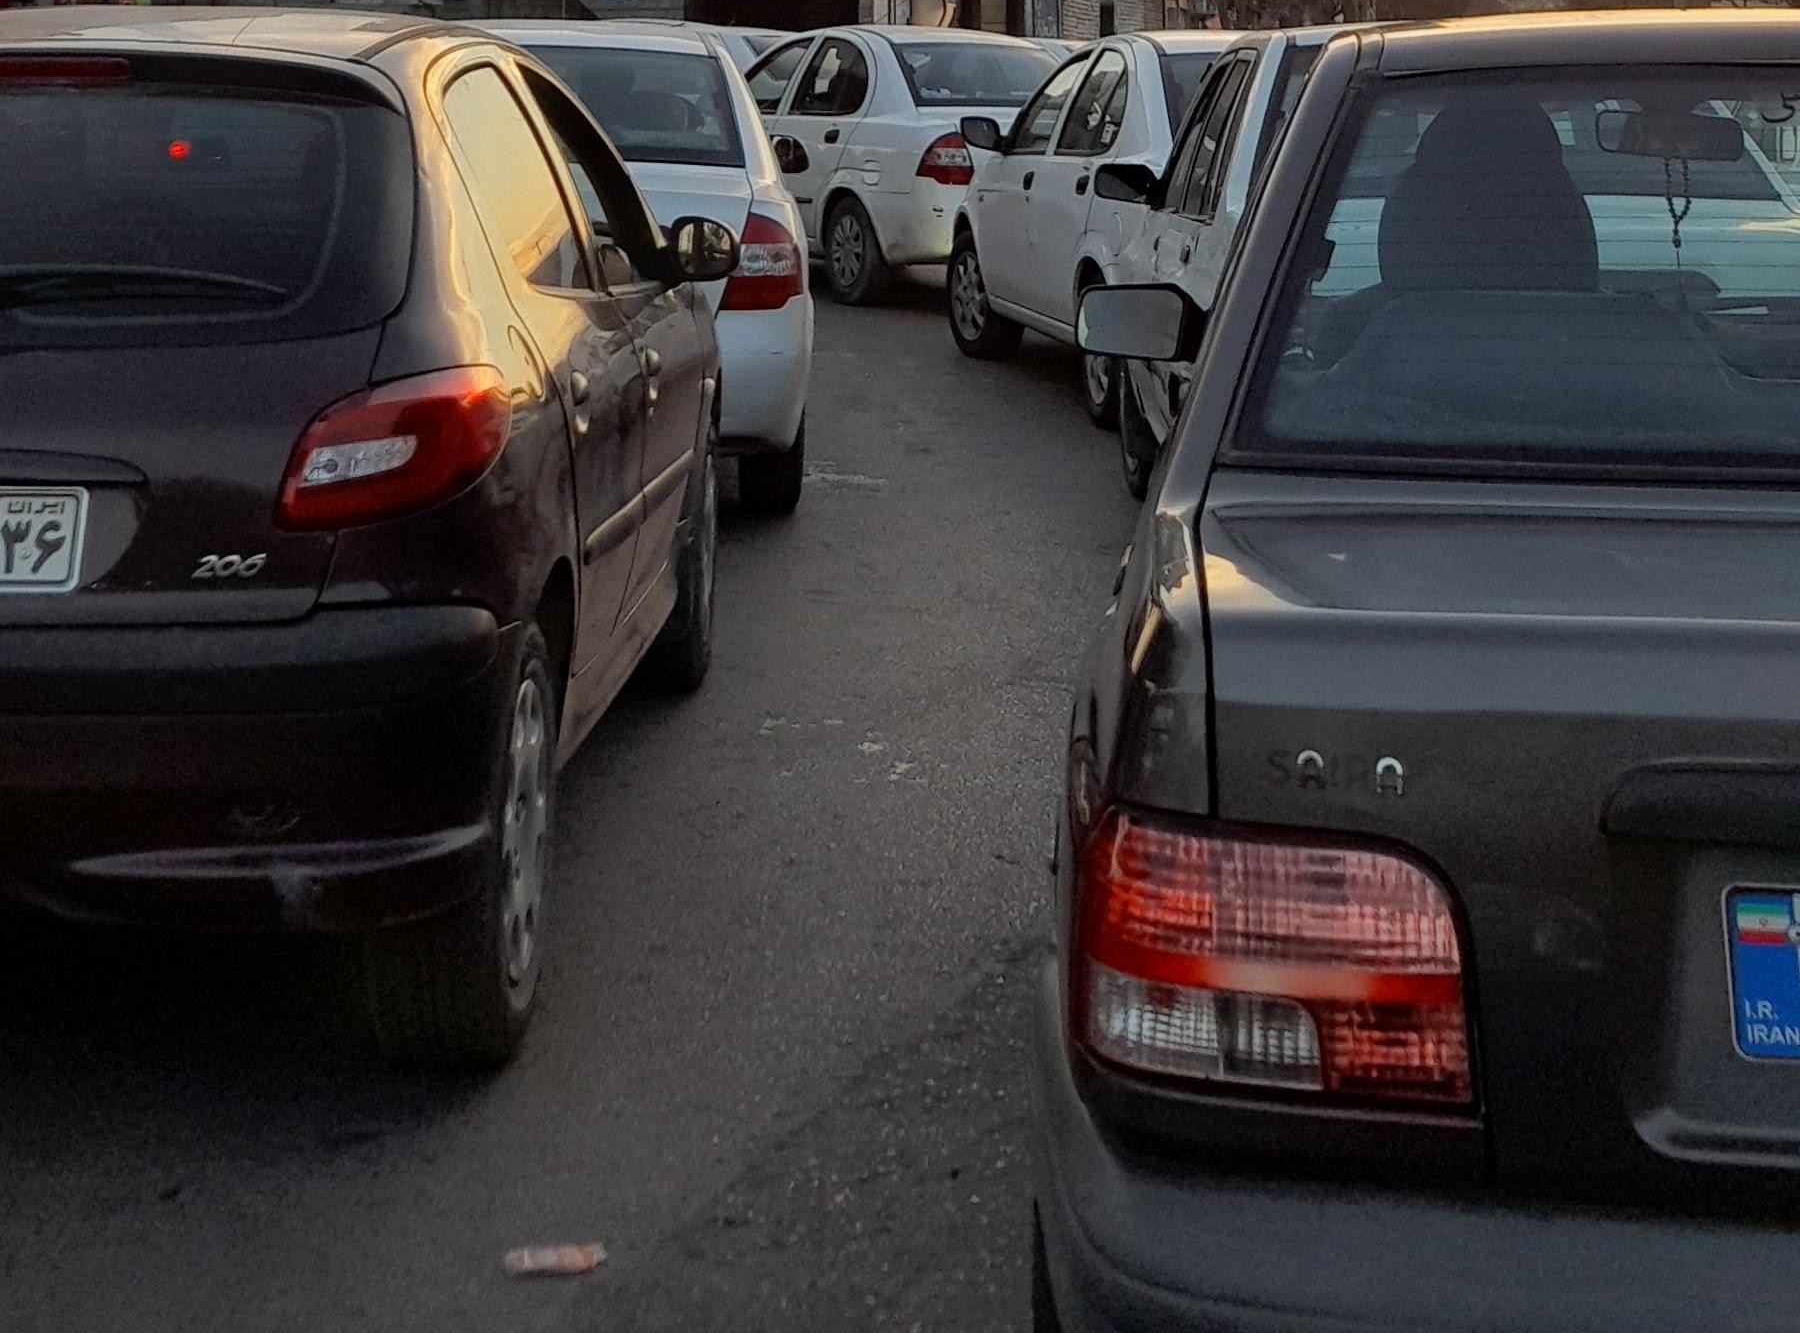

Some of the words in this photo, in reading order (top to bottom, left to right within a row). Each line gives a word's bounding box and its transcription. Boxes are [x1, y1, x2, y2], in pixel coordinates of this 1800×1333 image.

[8, 501, 65, 514] ایران
[0, 519, 66, 574] ۳۶
[191, 553, 267, 579] 206
[1744, 998, 1779, 1020] I.R.
[1746, 1023, 1800, 1046] IRAN
